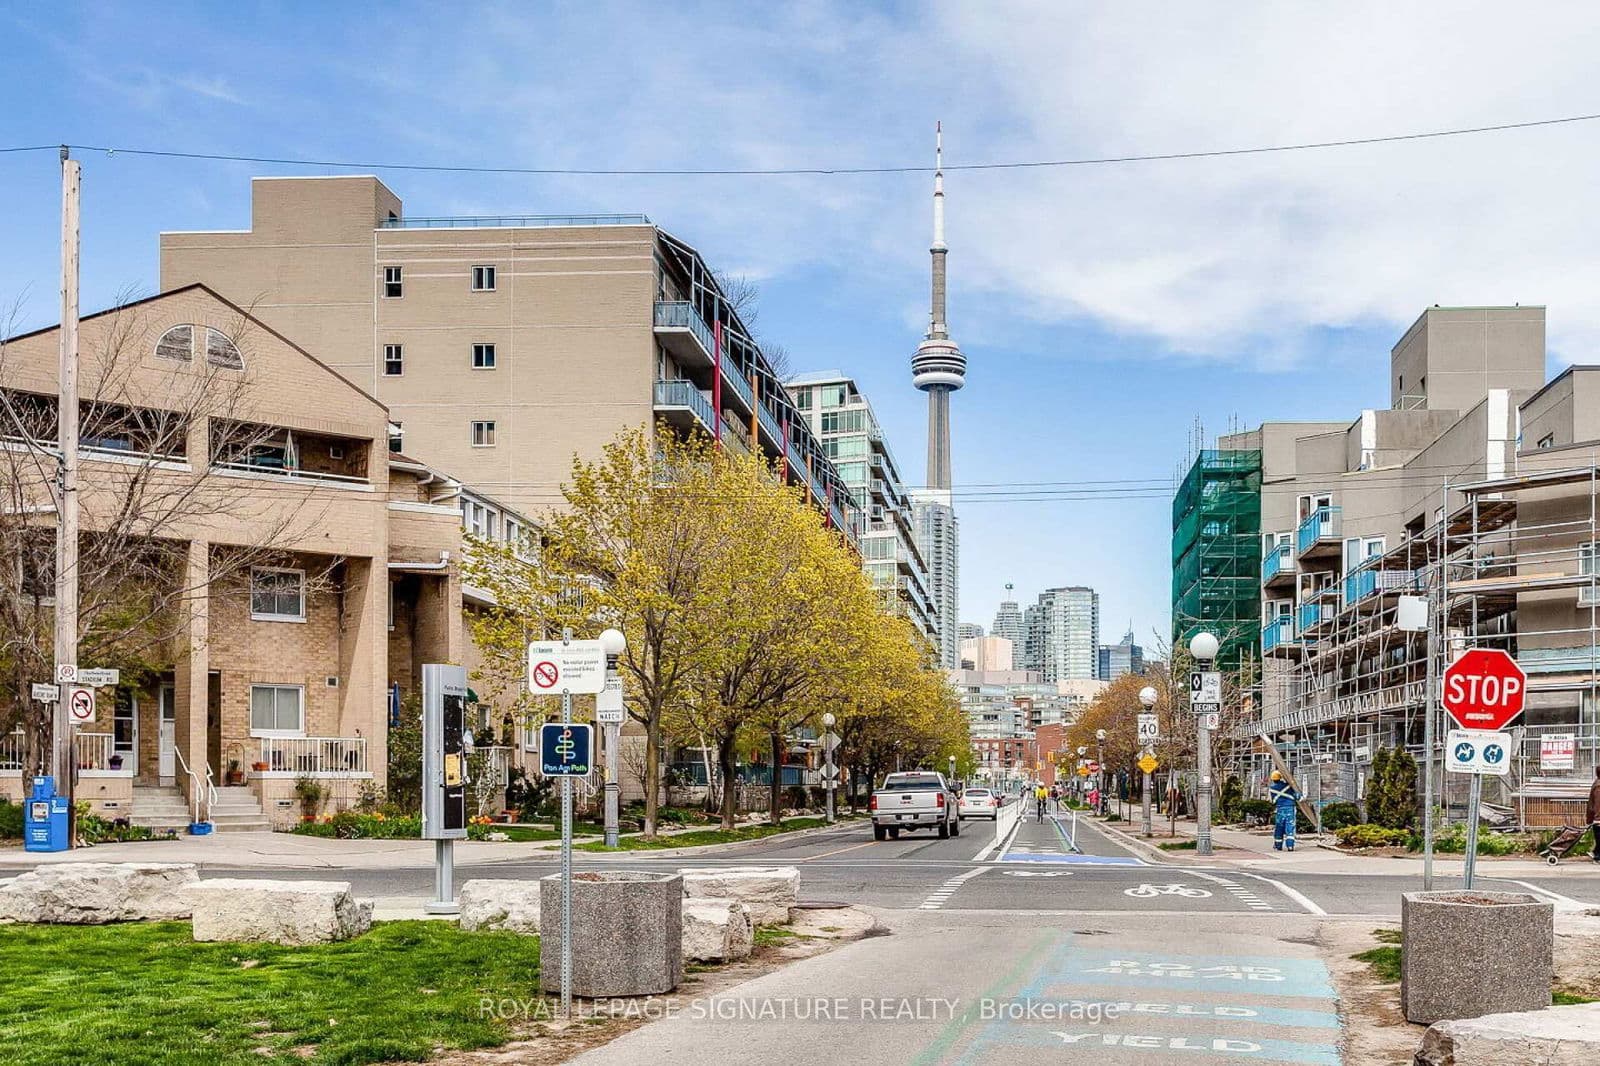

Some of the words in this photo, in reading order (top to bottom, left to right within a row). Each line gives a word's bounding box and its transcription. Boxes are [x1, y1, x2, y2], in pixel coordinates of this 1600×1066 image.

[1447, 673, 1520, 706] STOP
[1193, 703, 1217, 712] BEGINS
[1140, 723, 1157, 735] 40
[1109, 959, 1281, 974] ROAD
[1048, 1031, 1263, 1052] YIELD
